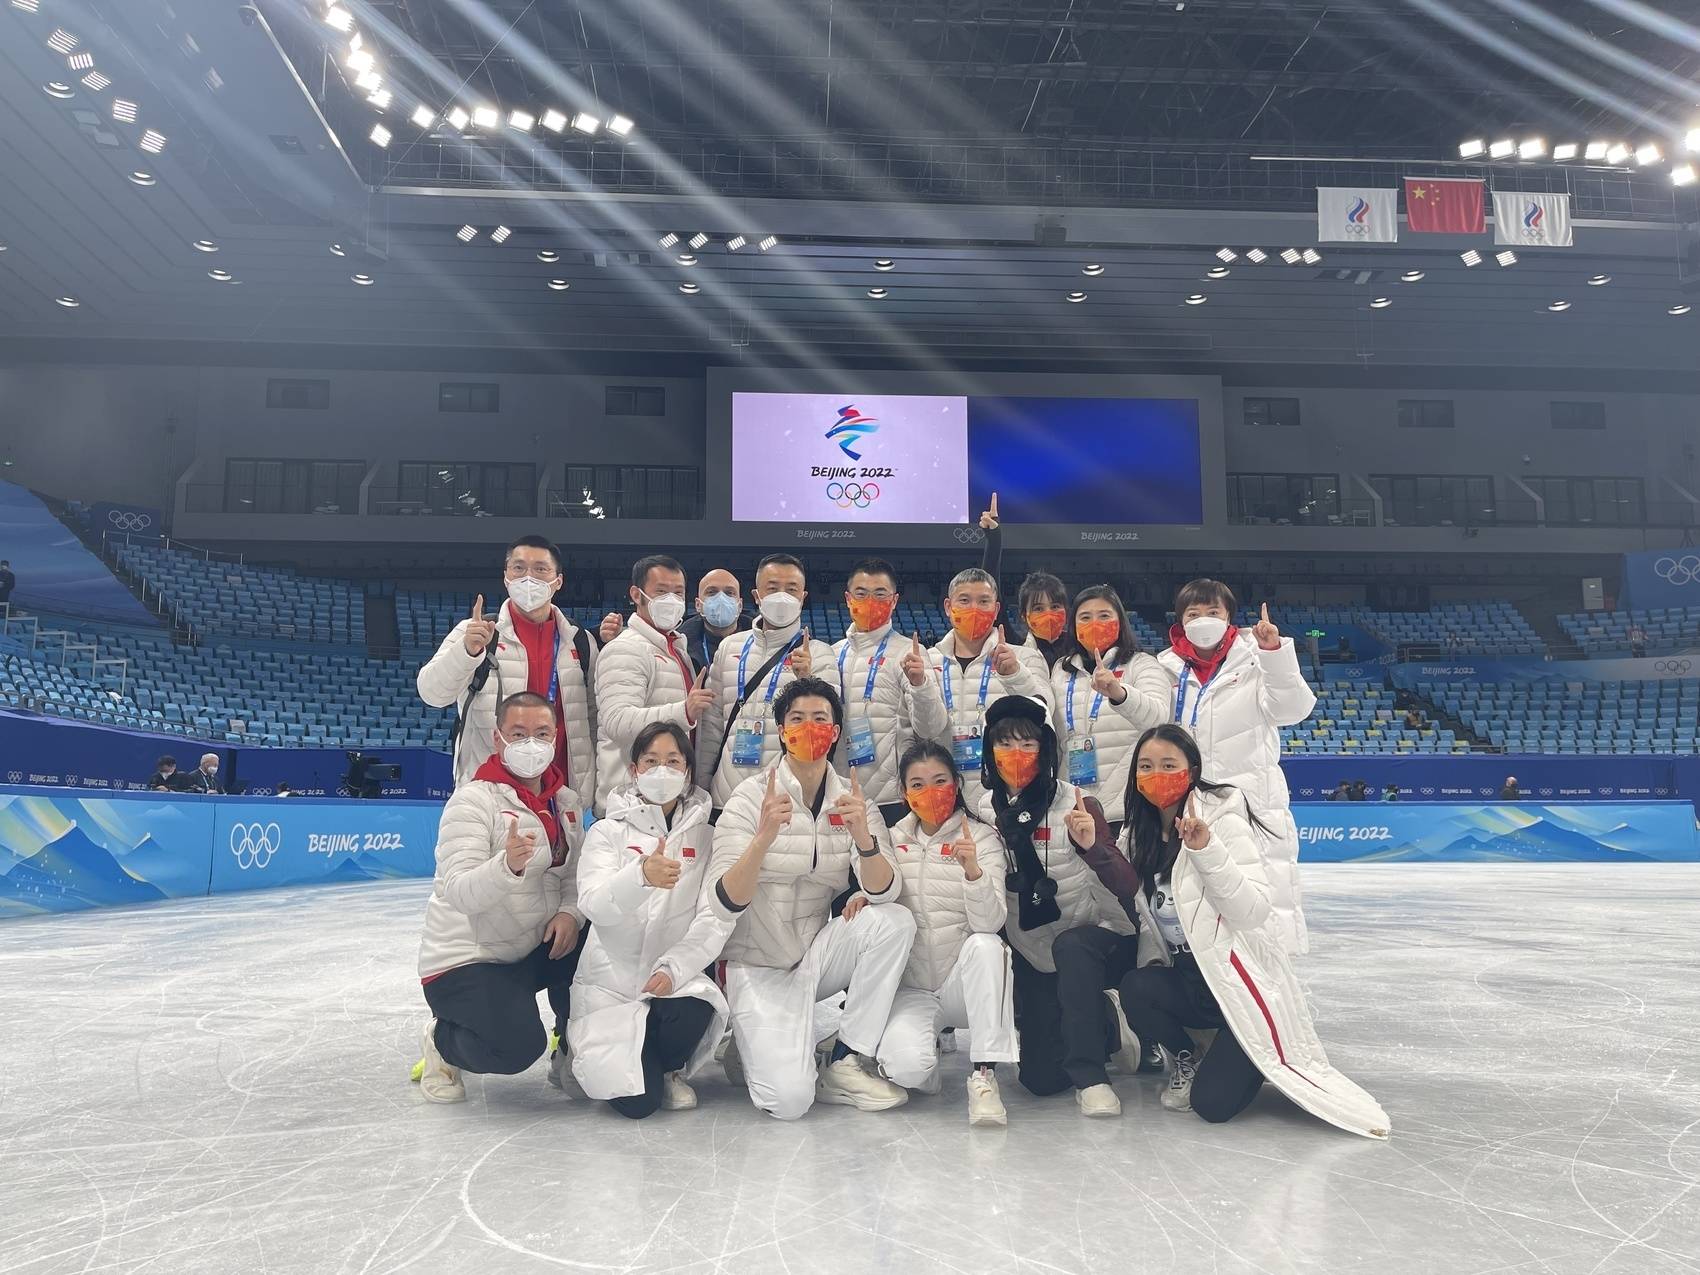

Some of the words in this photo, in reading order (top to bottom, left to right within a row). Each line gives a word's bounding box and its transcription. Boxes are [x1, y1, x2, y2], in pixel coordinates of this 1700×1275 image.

[811, 466, 856, 480] BEIJING
[860, 467, 895, 478] 2022
[797, 529, 830, 540] BEIJING
[831, 530, 857, 538] 2022
[1080, 532, 1113, 543] BEIJING
[1115, 532, 1140, 541] 2022
[1422, 667, 1451, 677] BEIJING
[1298, 826, 1345, 845] EIJING
[1349, 826, 1394, 841] 2022
[308, 833, 360, 858] BEIJING
[363, 832, 405, 850] 2022
